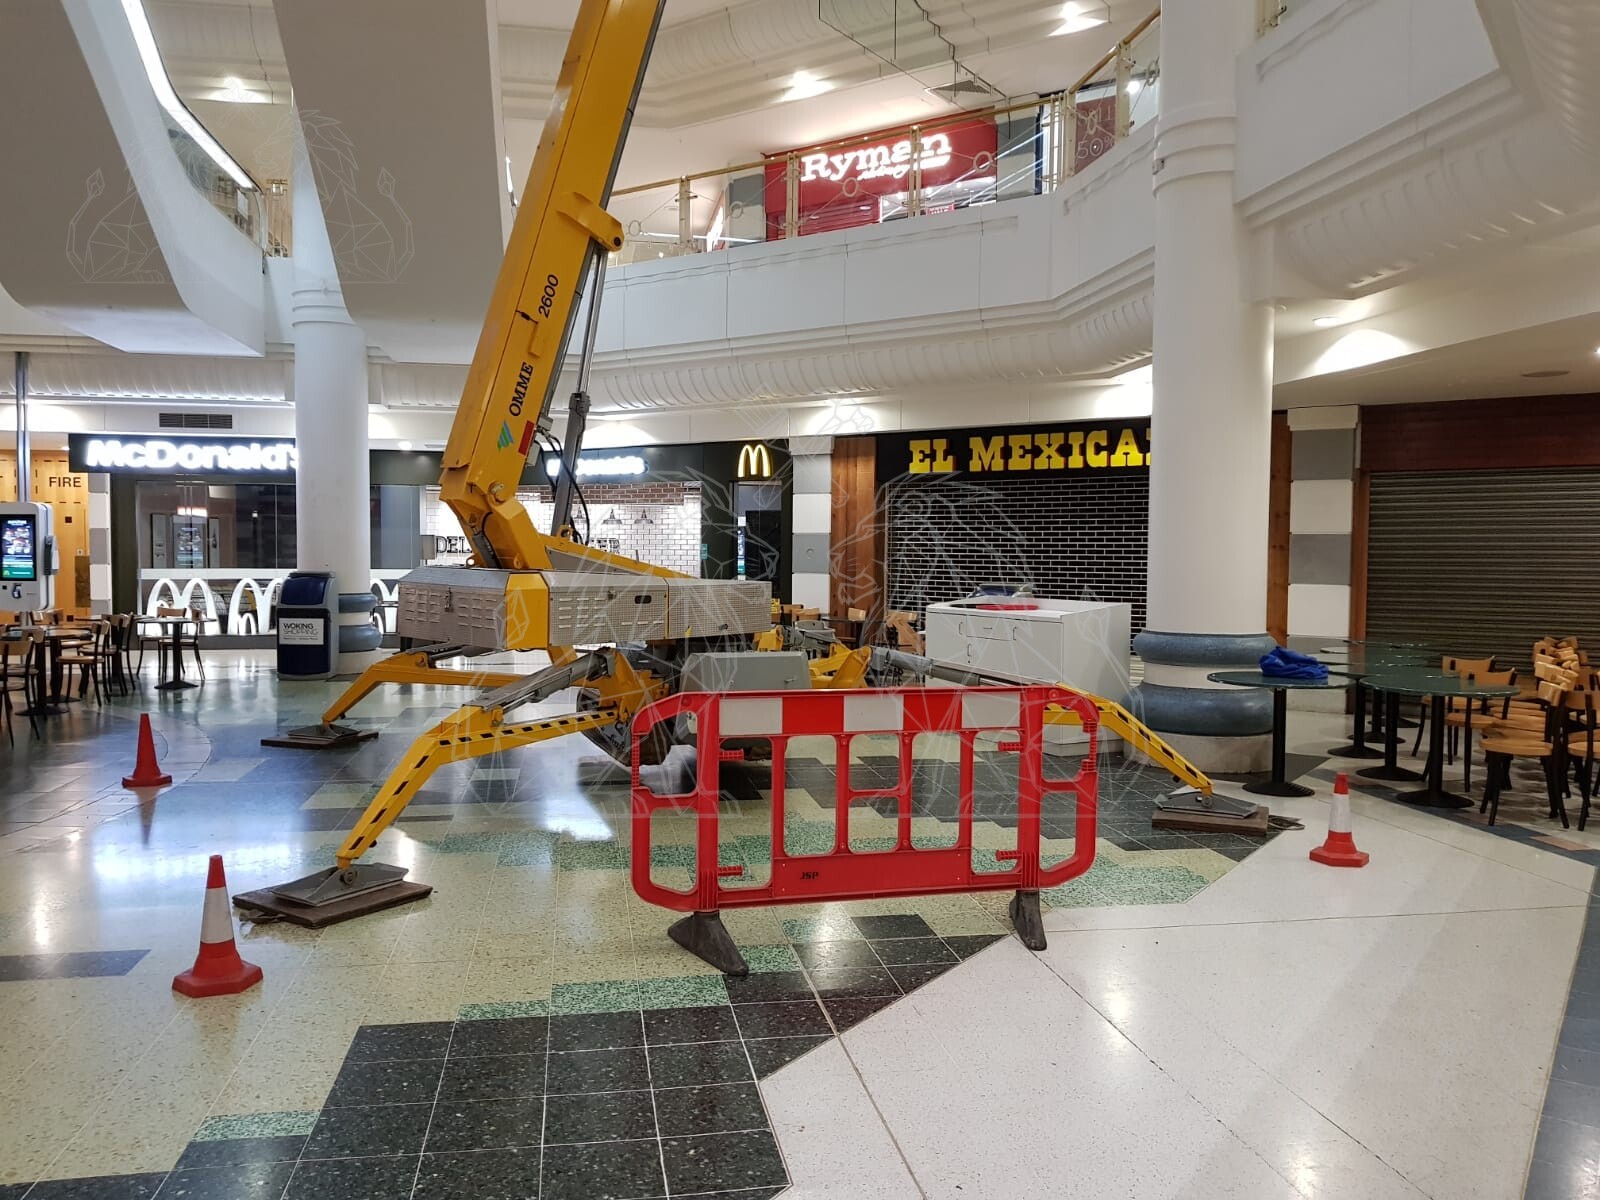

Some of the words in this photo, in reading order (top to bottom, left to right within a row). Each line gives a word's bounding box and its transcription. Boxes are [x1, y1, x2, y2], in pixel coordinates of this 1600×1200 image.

[800, 133, 952, 182] Ryman
[538, 274, 559, 318] 2600
[509, 361, 534, 417] OMME
[909, 438, 955, 474] EL
[969, 428, 1151, 472] MEXICA
[49, 476, 82, 488] FIRE
[283, 622, 314, 630] WOKING
[800, 871, 819, 880] JSP
